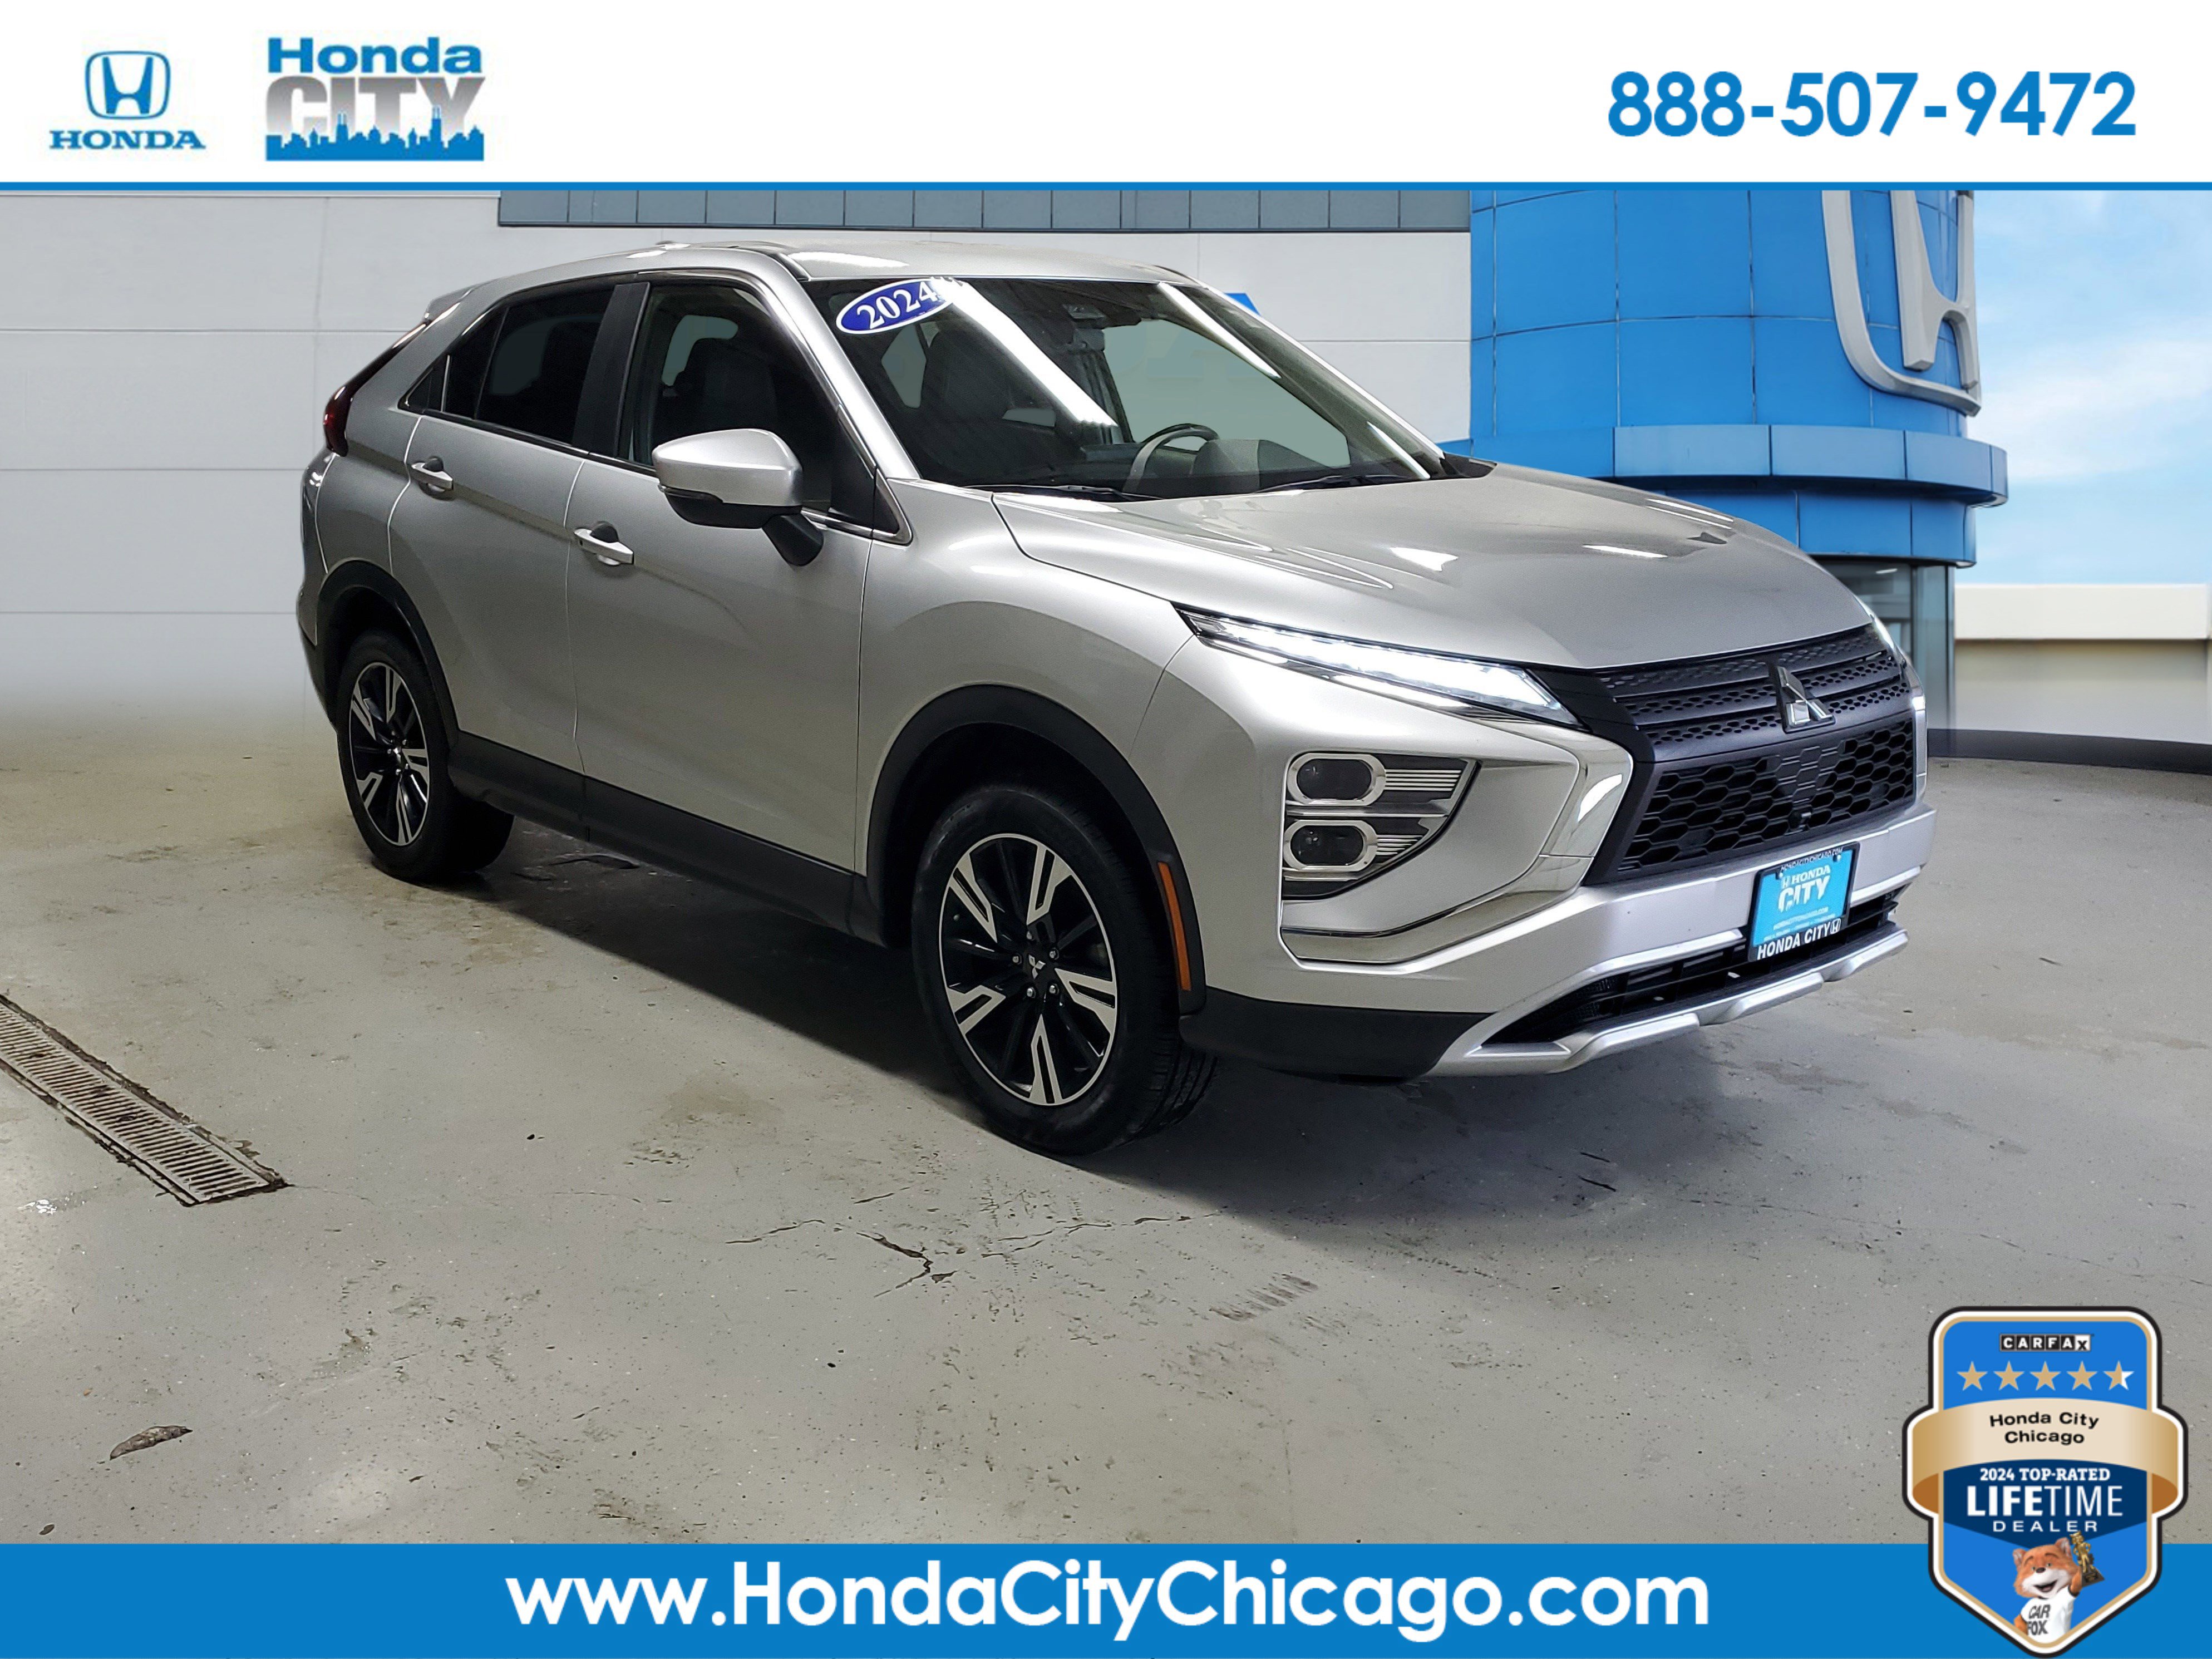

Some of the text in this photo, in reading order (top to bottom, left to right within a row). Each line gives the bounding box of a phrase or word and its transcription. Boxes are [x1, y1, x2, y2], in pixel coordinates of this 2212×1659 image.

[857, 281, 938, 329] 2024
[1791, 865, 1831, 883] HONDA
[1777, 875, 1831, 913] CITY
[1757, 932, 1801, 960] HONDA
[1804, 921, 1831, 944] CITY
